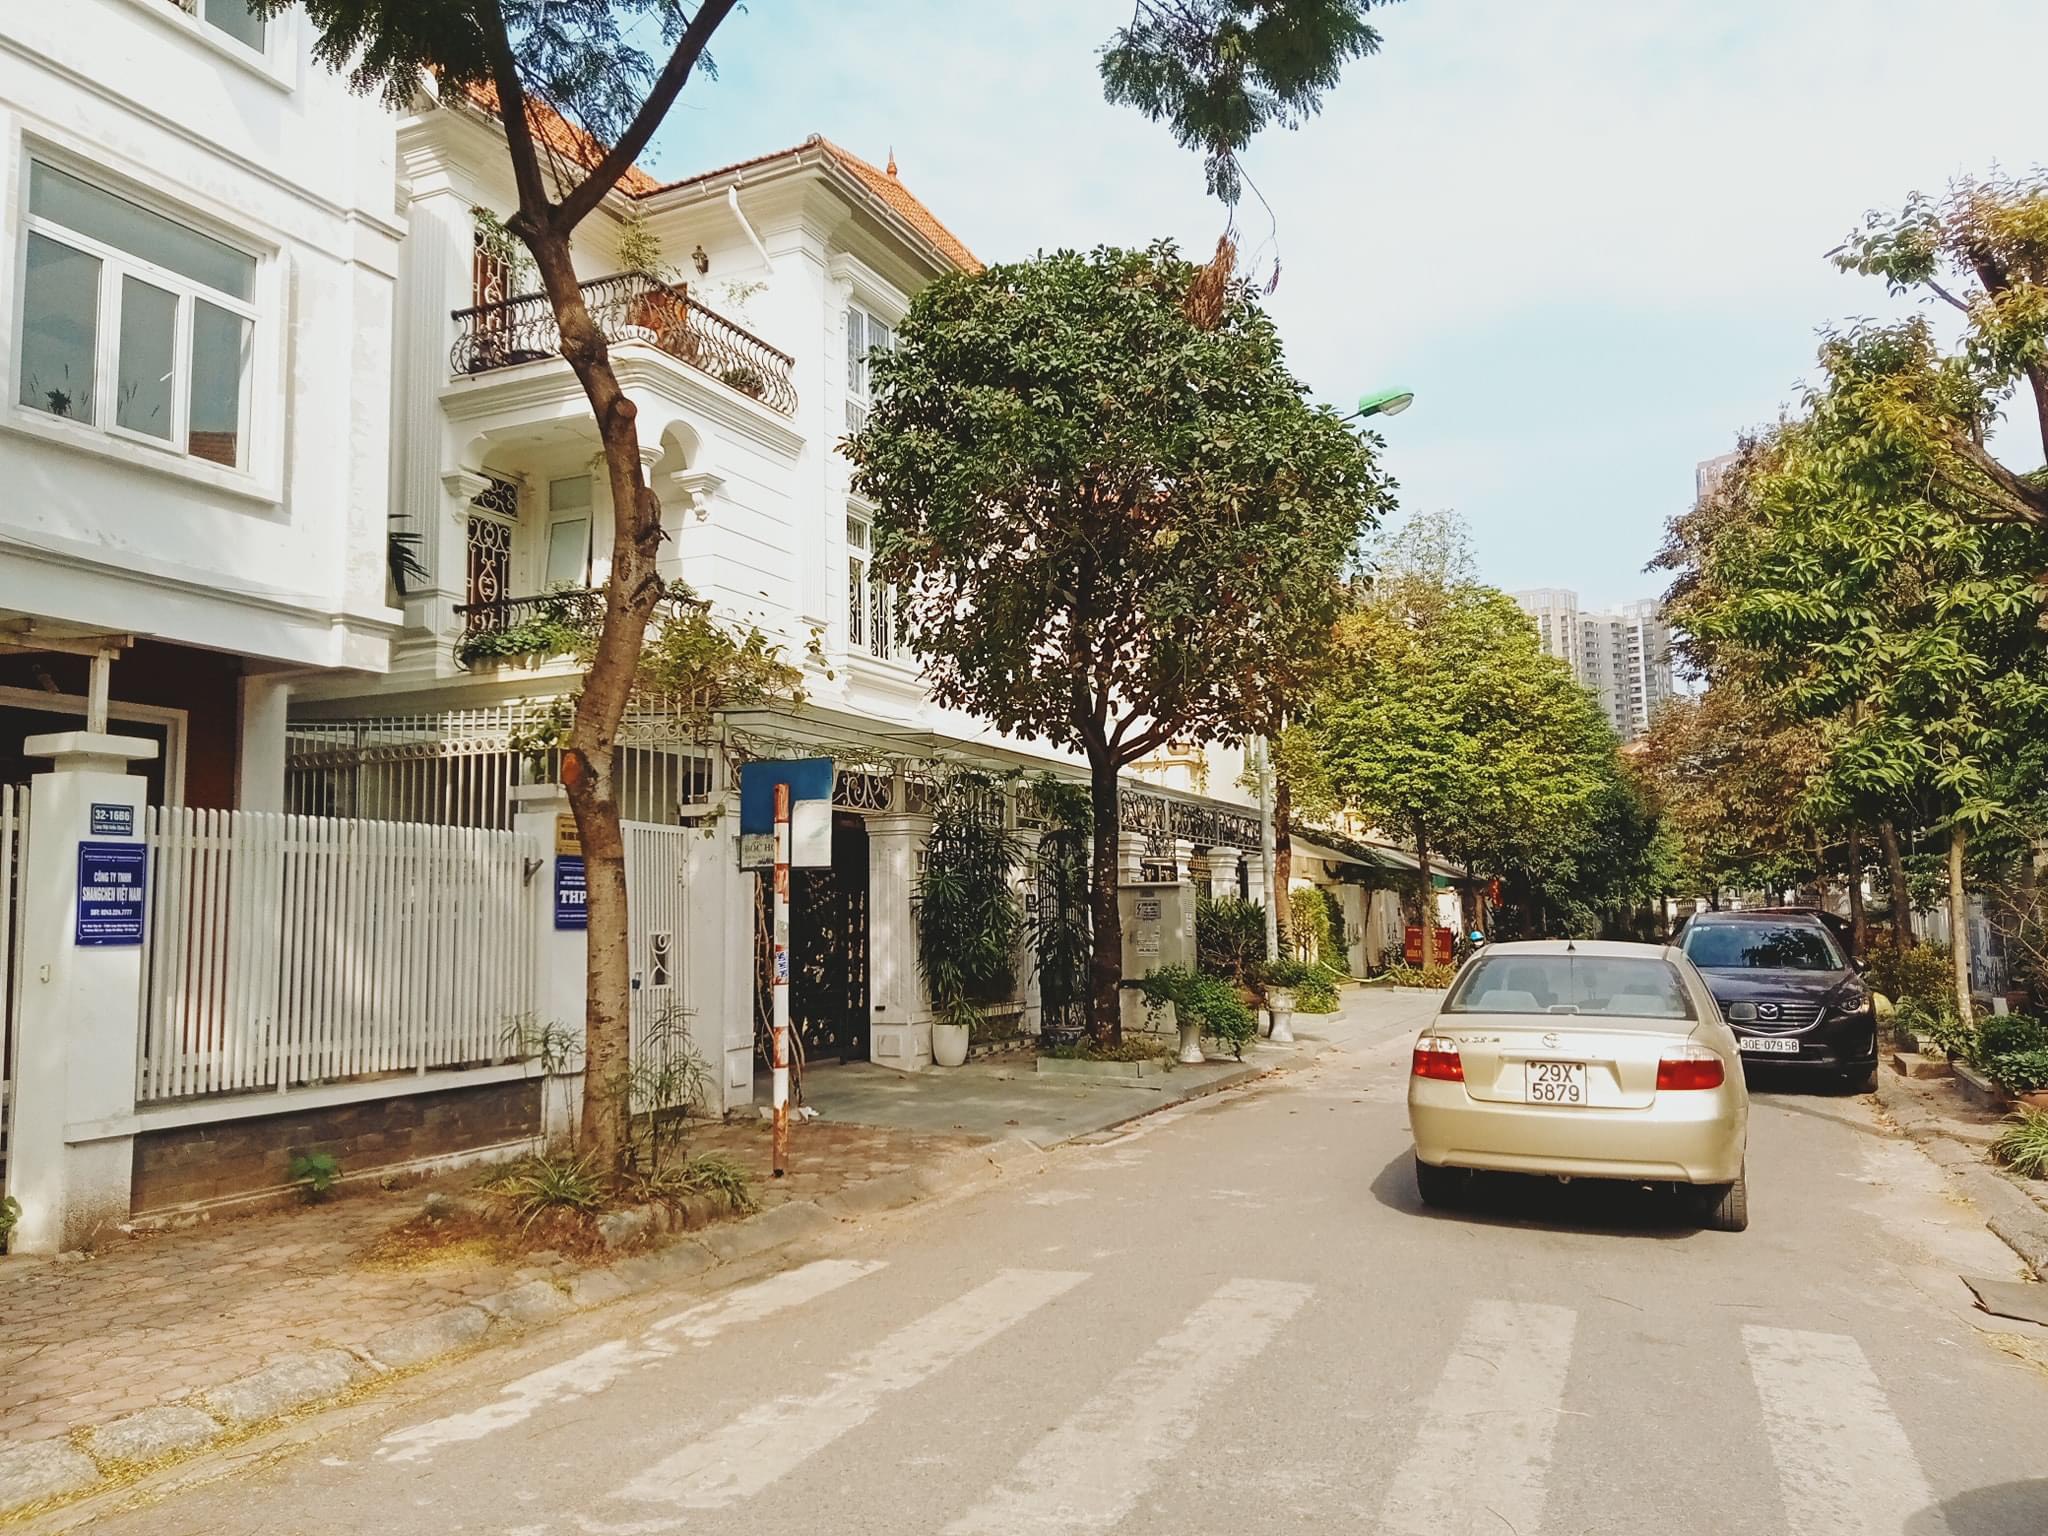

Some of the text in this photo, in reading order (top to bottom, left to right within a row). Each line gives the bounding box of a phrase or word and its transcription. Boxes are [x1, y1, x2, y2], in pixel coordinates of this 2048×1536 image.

[94, 870, 131, 883] CÔNG TY TNHH
[128, 887, 142, 902] NAM
[1538, 1064, 1573, 1083] 29X
[1533, 1083, 1580, 1102] 5879
